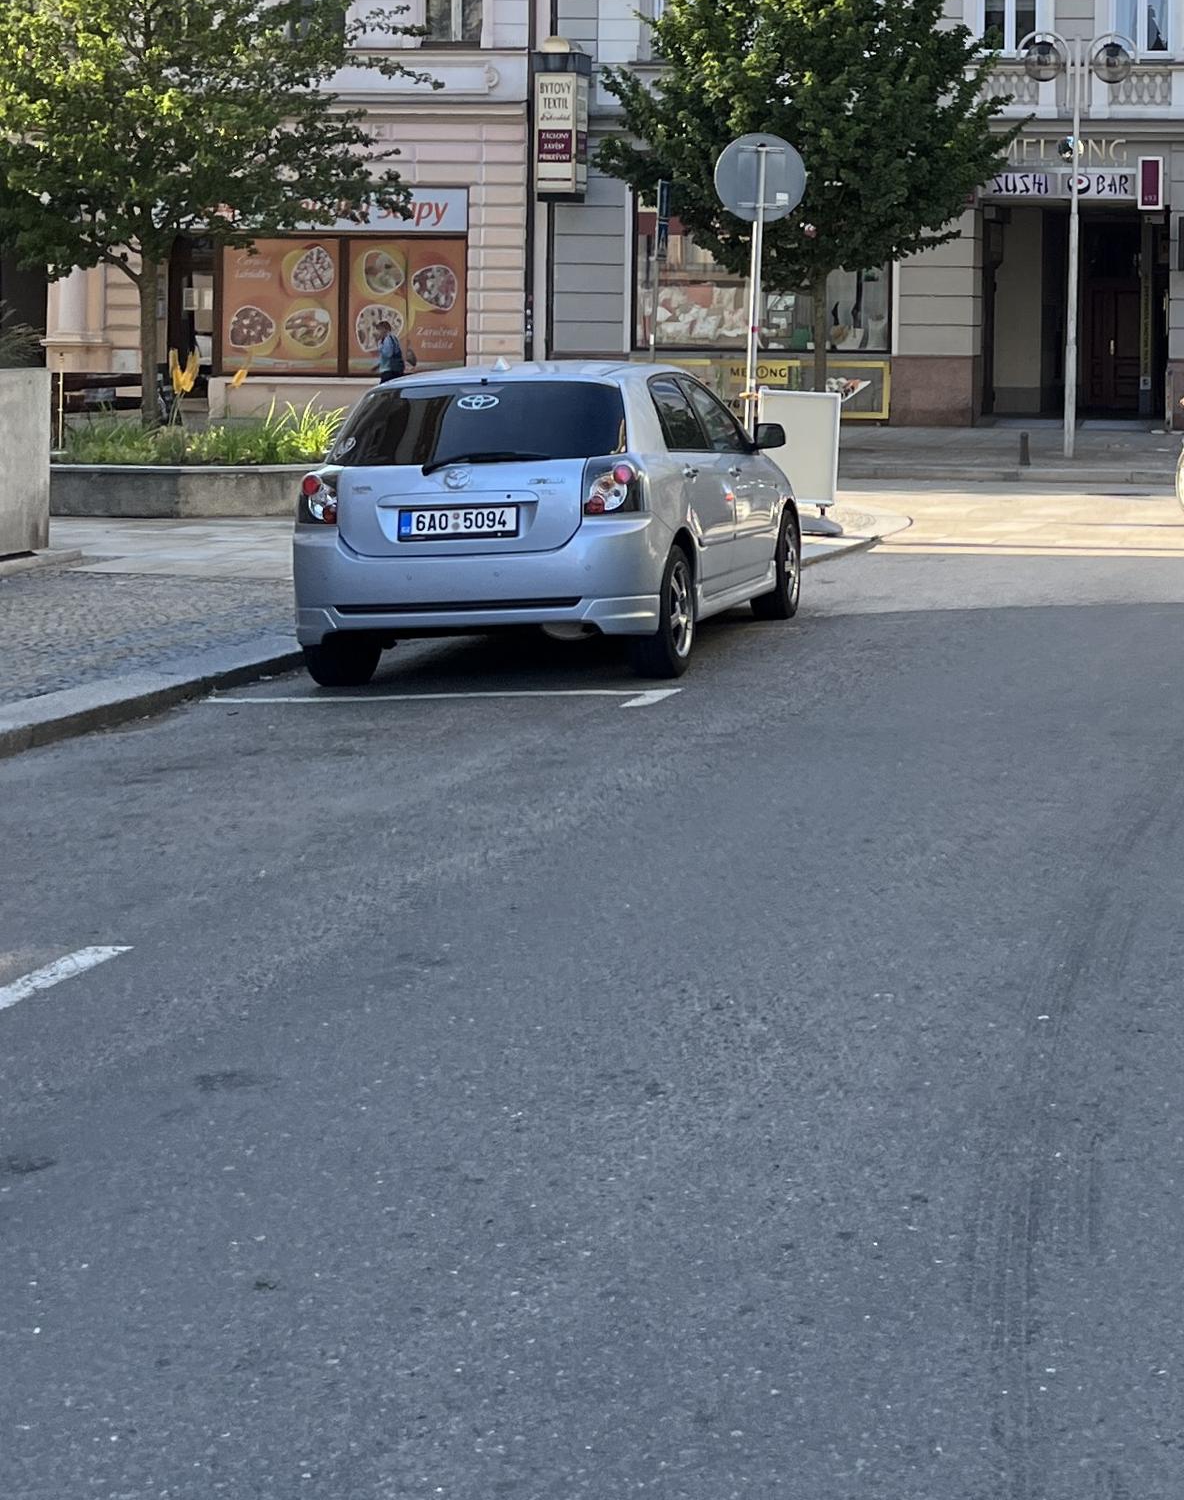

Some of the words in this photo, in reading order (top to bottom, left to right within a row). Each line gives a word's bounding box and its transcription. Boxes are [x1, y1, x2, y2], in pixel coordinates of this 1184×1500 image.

[543, 97, 568, 109] TEXTIL
[1003, 138, 1127, 160] MELNG
[992, 173, 1049, 195] SUSHI
[1096, 174, 1129, 195] BAR
[730, 366, 787, 379] MEONG
[463, 510, 507, 529] 5094
